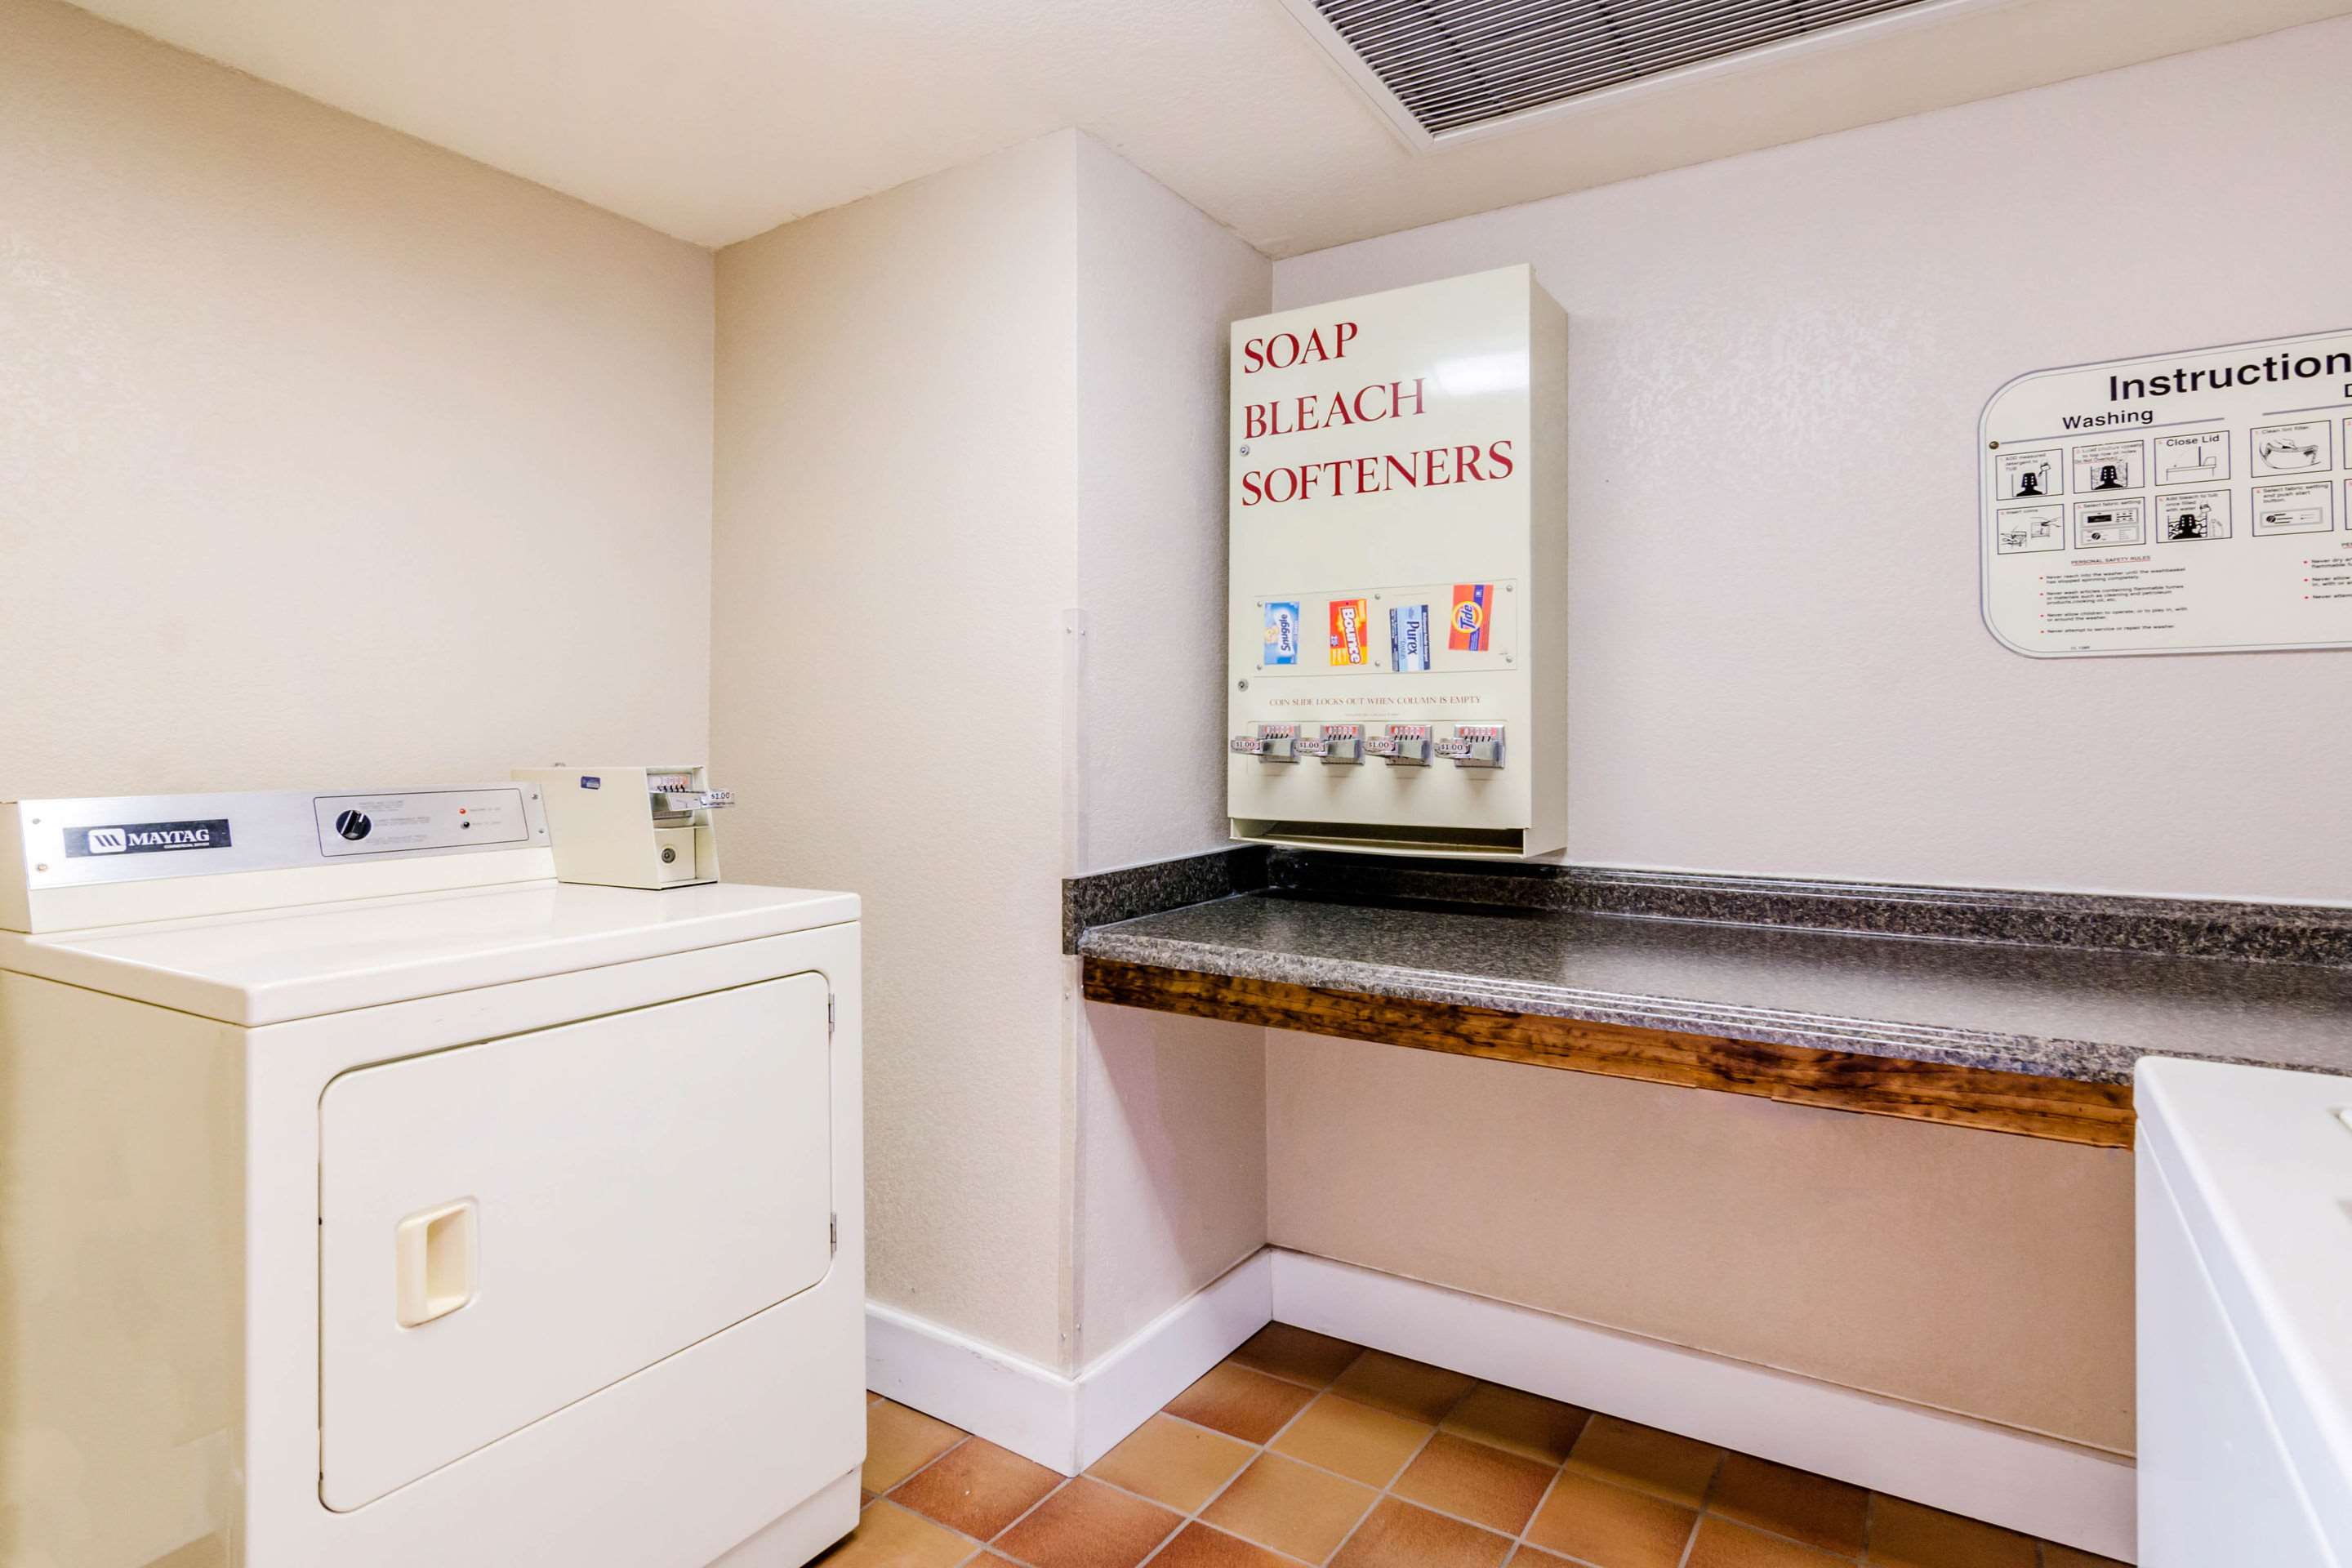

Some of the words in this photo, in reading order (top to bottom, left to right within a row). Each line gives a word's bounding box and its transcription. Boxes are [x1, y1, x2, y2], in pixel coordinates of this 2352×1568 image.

[1244, 322, 1358, 374] SOAP
[1243, 377, 1427, 439] BLEACH
[2063, 409, 2154, 430] Washing
[2166, 435, 2198, 447] Close
[2201, 434, 2220, 443] Lid
[1242, 440, 1513, 506] SOFTENERS
[1279, 614, 1291, 651] Snuggle
[1460, 604, 1477, 629] Tide
[1340, 607, 1361, 664] Bounce
[1406, 621, 1420, 655] Purex
[1269, 698, 1290, 706] COIN
[1292, 698, 1313, 706] SLIDE
[1316, 697, 1344, 706] LOCKS
[1346, 697, 1366, 706] OUT
[1367, 697, 1395, 705] WHEN
[1396, 696, 1437, 705] COLUMN
[1439, 696, 1448, 704] IS
[1450, 695, 1481, 704] EMPTY
[127, 829, 210, 846] MAYTAG
